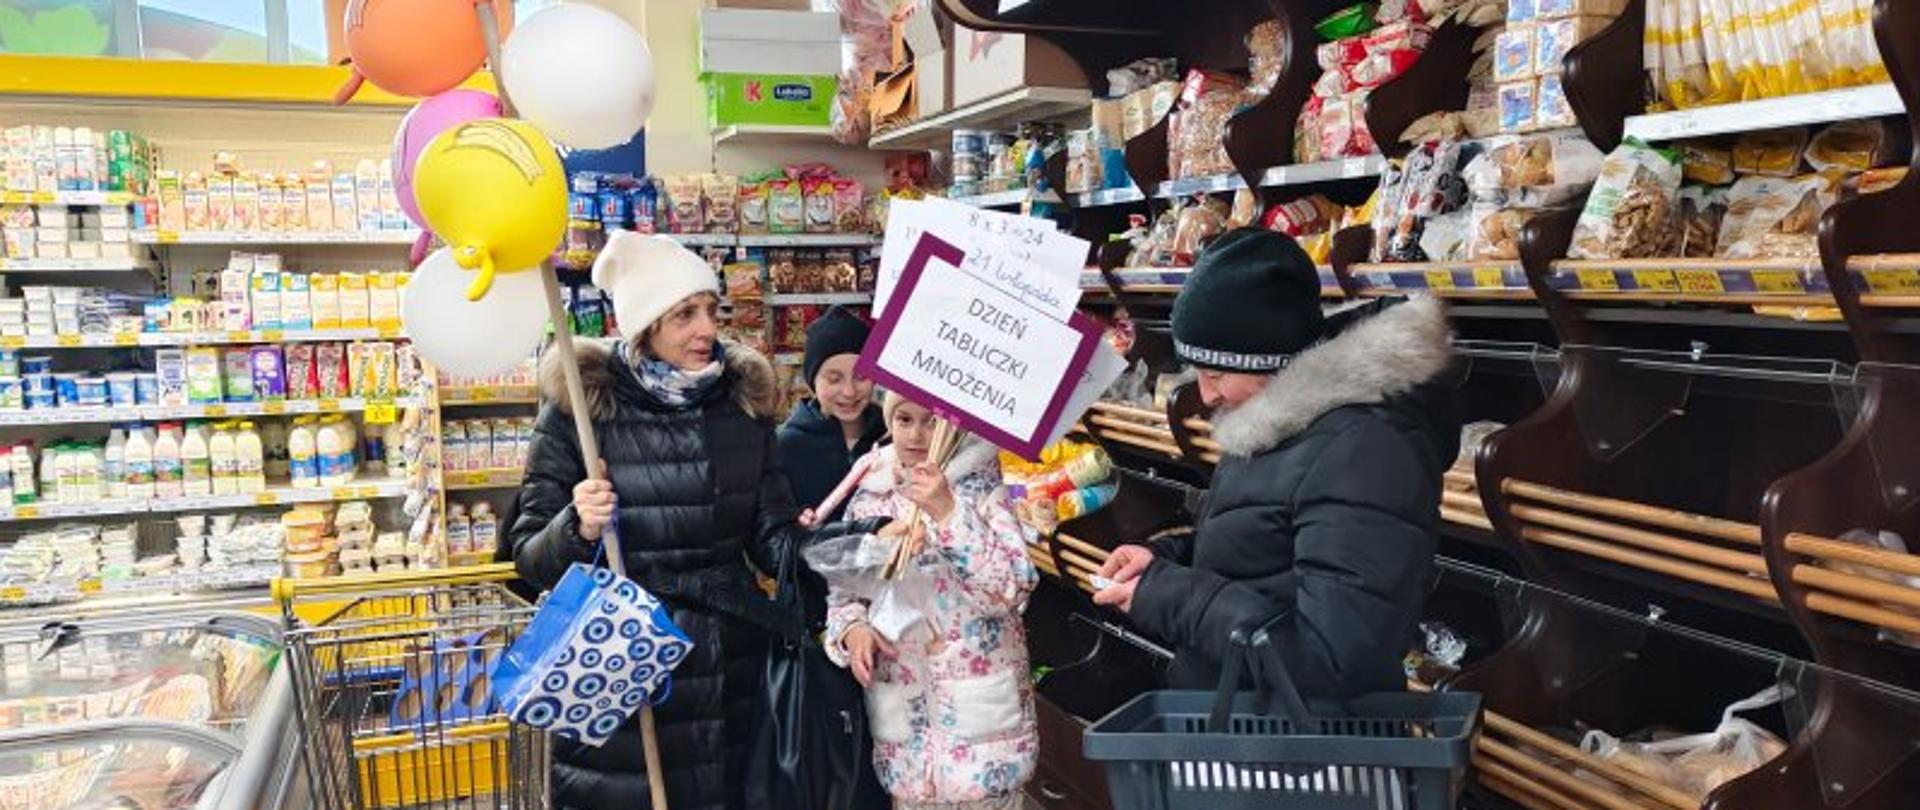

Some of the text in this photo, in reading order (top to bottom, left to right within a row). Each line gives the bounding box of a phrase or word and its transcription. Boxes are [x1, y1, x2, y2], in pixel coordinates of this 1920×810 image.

[969, 211, 980, 228] 8
[997, 219, 1009, 236] 3
[968, 298, 1029, 341] DZIEŃ
[936, 320, 1029, 380] TABLICZKI
[911, 349, 1017, 416] MNOŻENIA
